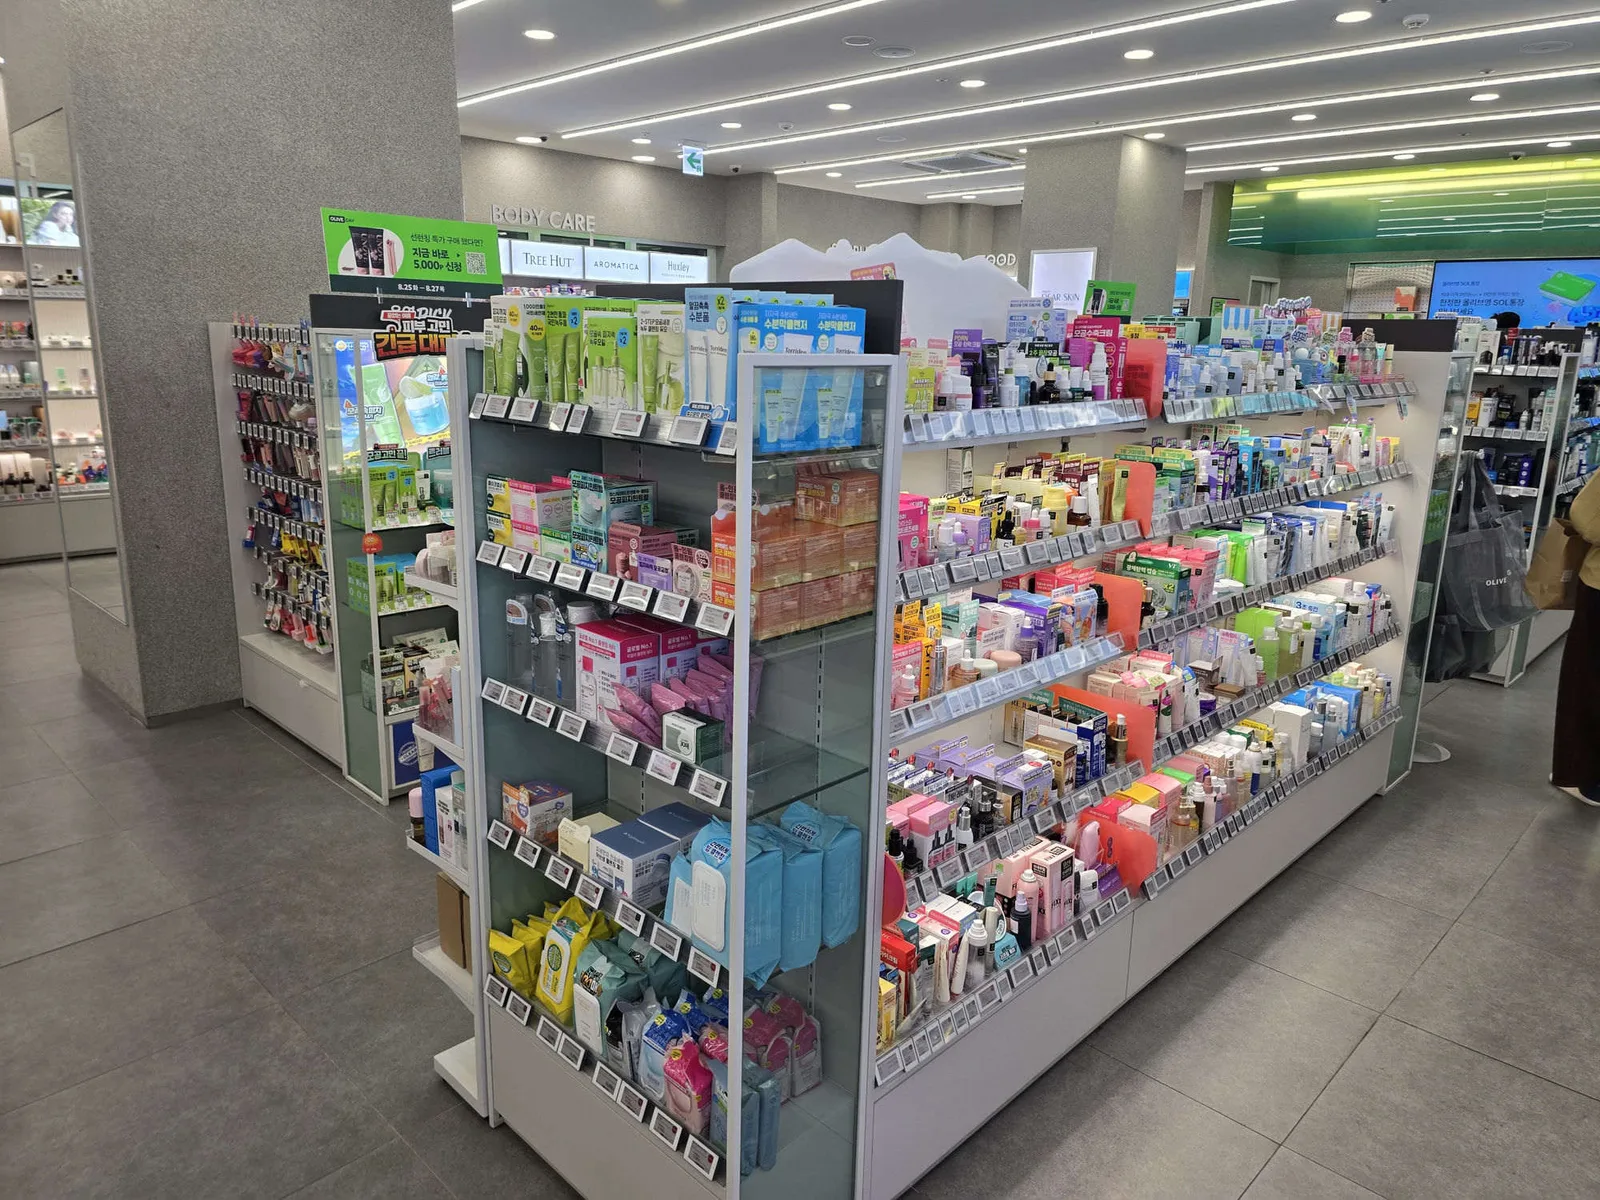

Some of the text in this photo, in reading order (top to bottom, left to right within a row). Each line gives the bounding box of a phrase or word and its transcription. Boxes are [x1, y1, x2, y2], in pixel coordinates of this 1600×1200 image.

[491, 204, 595, 233] BODY CARE
[447, 237, 460, 246] 구매
[412, 248, 450, 259] 지금 바로
[522, 252, 574, 268] TREE HUT
[985, 253, 1016, 266] OOD
[445, 261, 462, 272] 신청
[594, 261, 639, 271] AROMATICA
[667, 260, 690, 273] Huxley
[689, 312, 710, 323] 수분폼
[375, 333, 417, 357] 긴급
[1485, 576, 1507, 586] OLIVE
